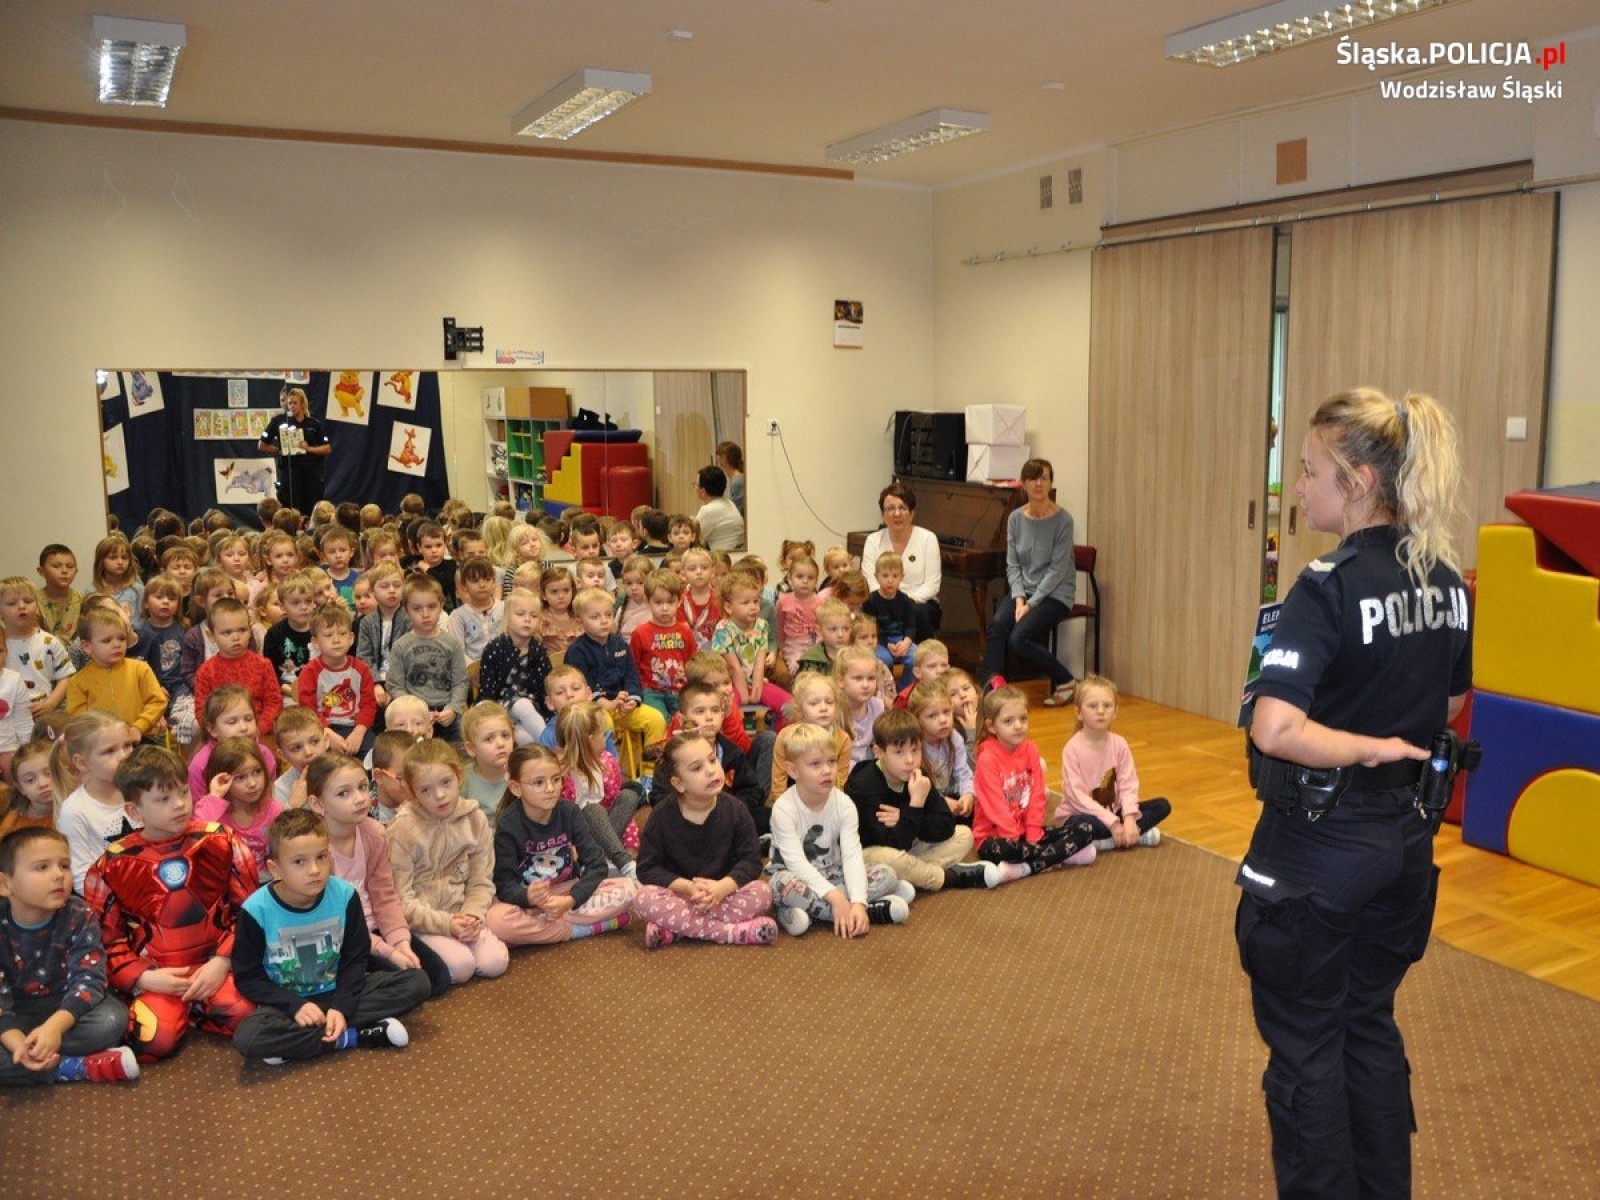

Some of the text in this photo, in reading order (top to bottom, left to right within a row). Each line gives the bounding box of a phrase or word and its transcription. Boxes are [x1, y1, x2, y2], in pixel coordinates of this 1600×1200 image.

[1359, 586, 1468, 644] POLICJA
[655, 632, 681, 641] SUPER
[651, 639, 684, 650] MARIO
